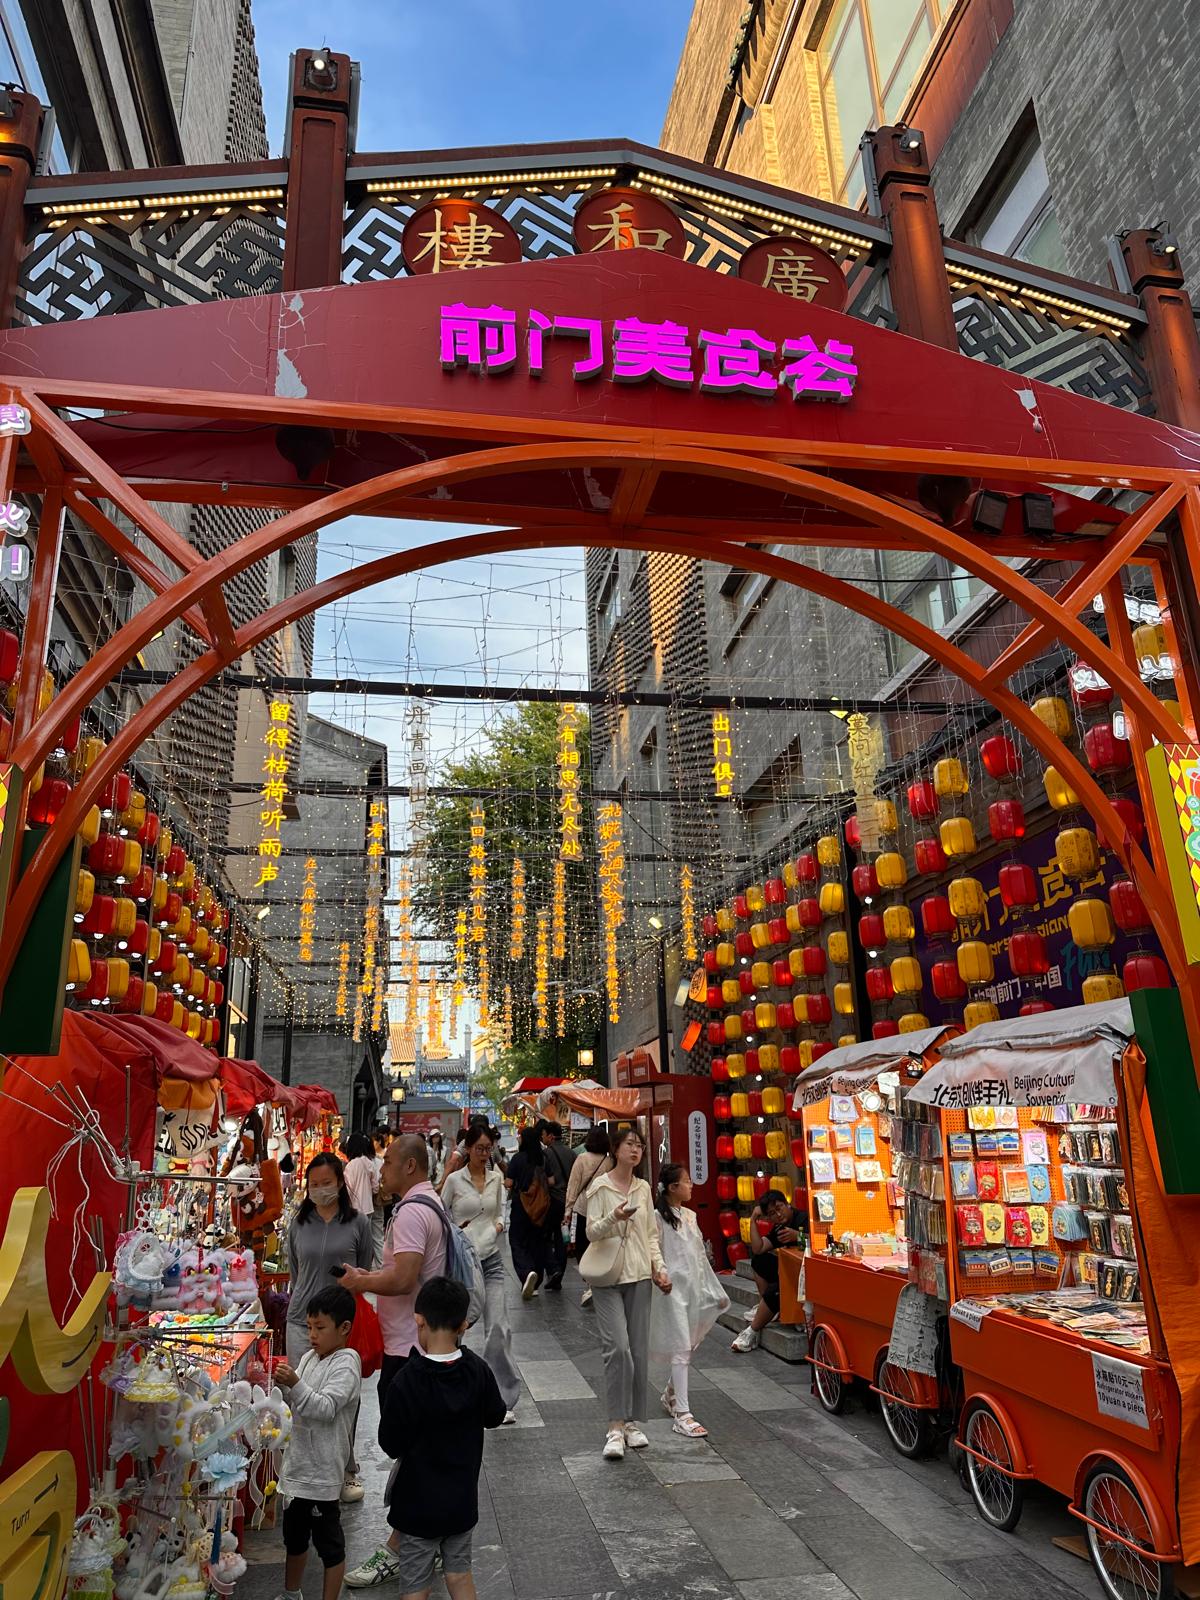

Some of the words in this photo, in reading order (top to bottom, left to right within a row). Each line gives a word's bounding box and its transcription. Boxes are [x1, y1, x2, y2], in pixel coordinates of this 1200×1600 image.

[440, 303, 858, 399] 前门美食荟
[254, 700, 292, 887] 留得枯荷听雨声
[558, 704, 582, 858] 只有相思无尽处
[1014, 1074, 1043, 1091] Beijing
